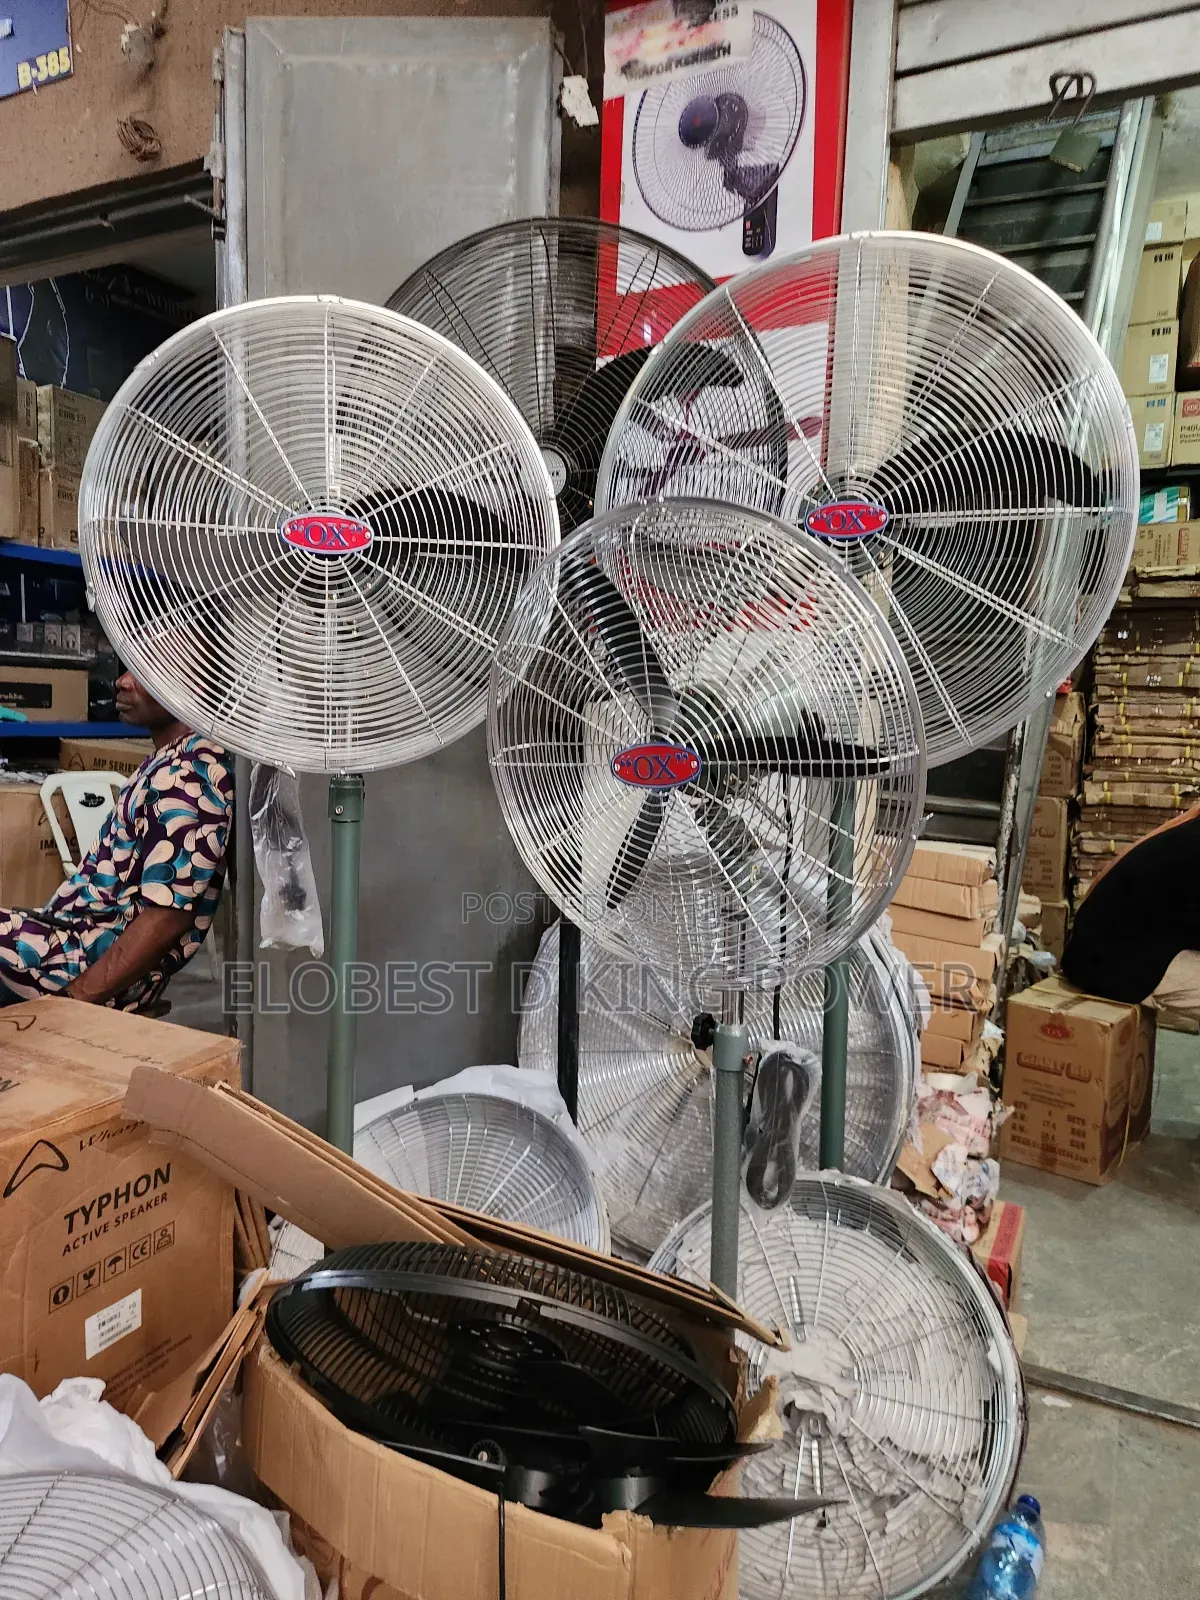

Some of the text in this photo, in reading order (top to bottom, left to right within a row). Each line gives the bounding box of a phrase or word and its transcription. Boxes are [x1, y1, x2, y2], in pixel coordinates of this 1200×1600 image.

[18, 46, 71, 90] B-385
[93, 757, 107, 768] MP
[62, 1191, 169, 1257] ACTIVE SPEAKER
[64, 1161, 172, 1236] TYPHON
